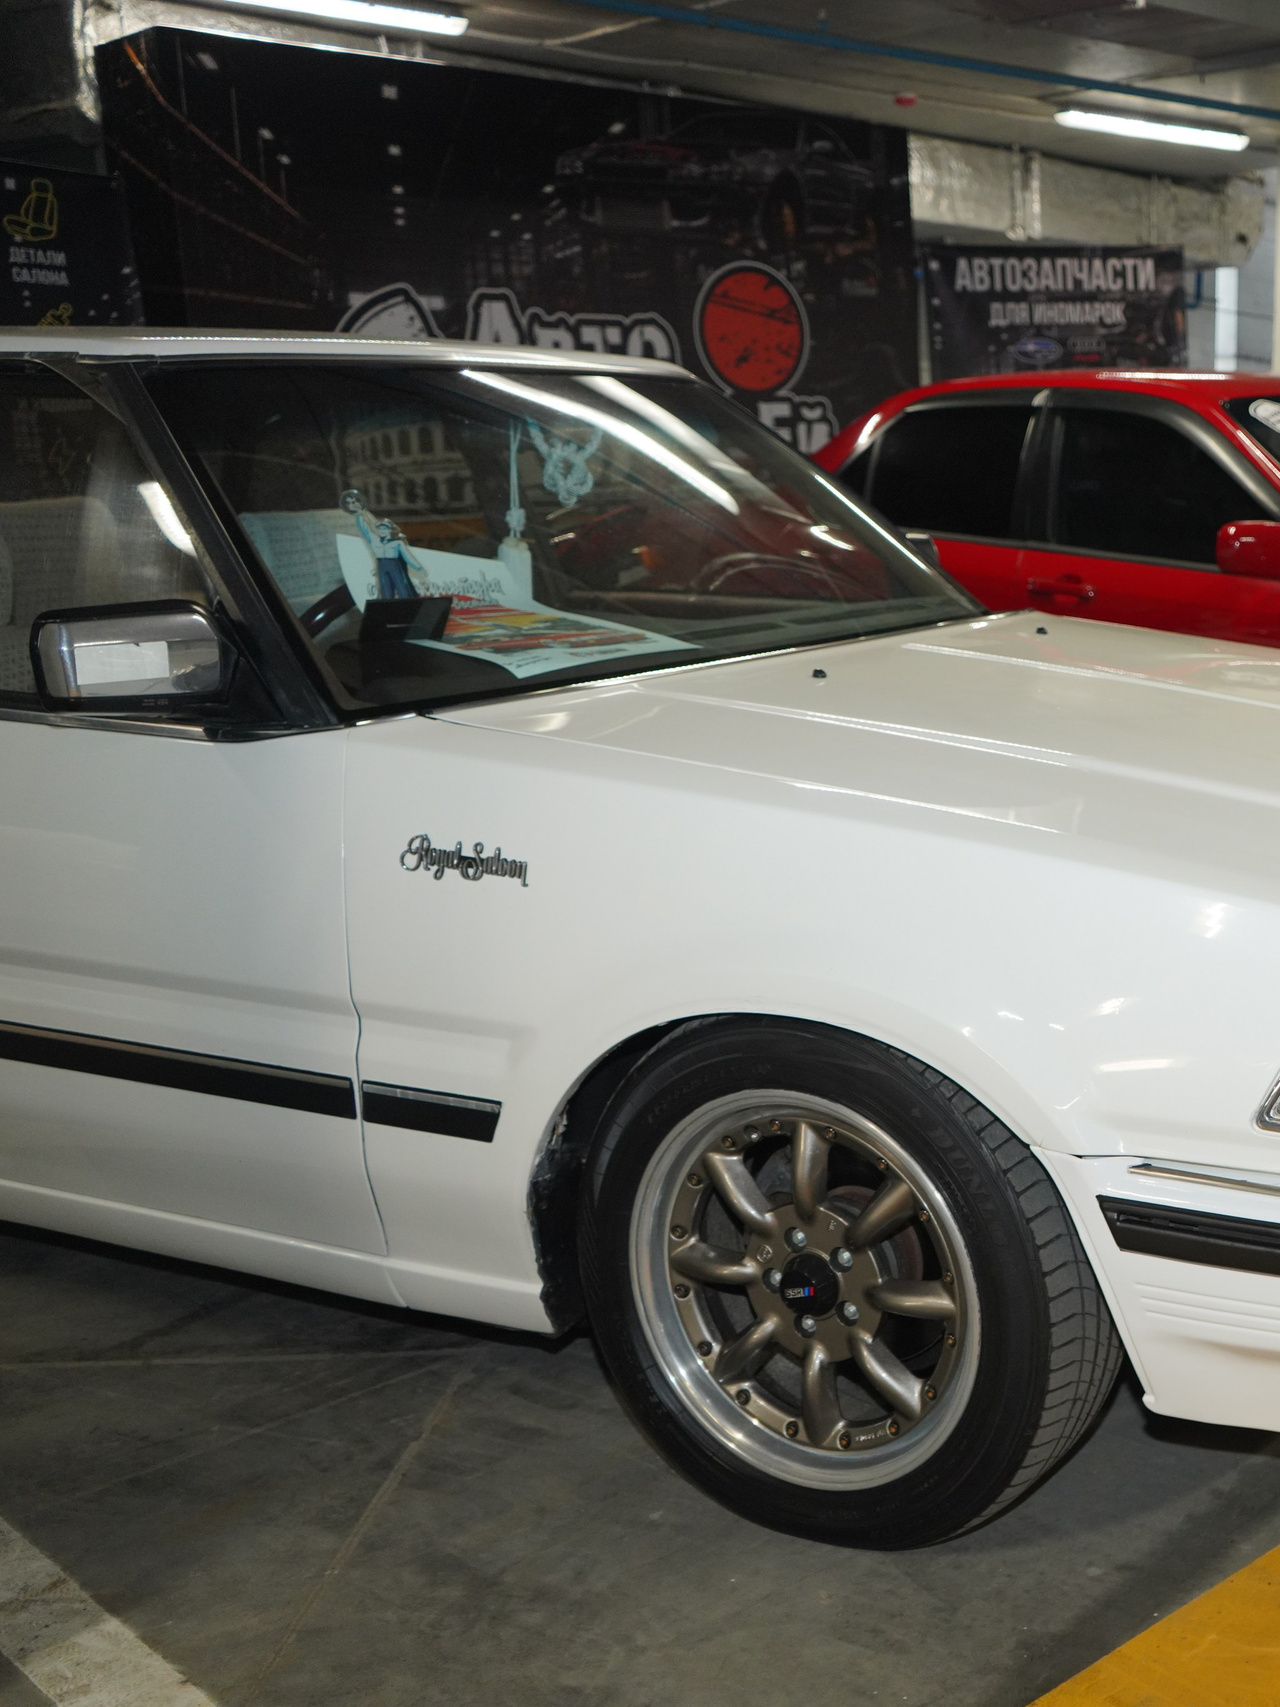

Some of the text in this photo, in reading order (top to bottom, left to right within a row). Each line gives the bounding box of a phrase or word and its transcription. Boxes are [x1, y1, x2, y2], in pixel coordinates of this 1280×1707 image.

[9, 246, 67, 267] ДЕТАЛИ
[12, 267, 70, 287] САЛОНА
[954, 256, 1157, 293] АВТОЗАПЧАСТИ
[988, 302, 1127, 328] ДЛЯ ИНОМАРОК
[400, 833, 529, 887] Royal Saloon
[784, 1287, 804, 1299] SSR
